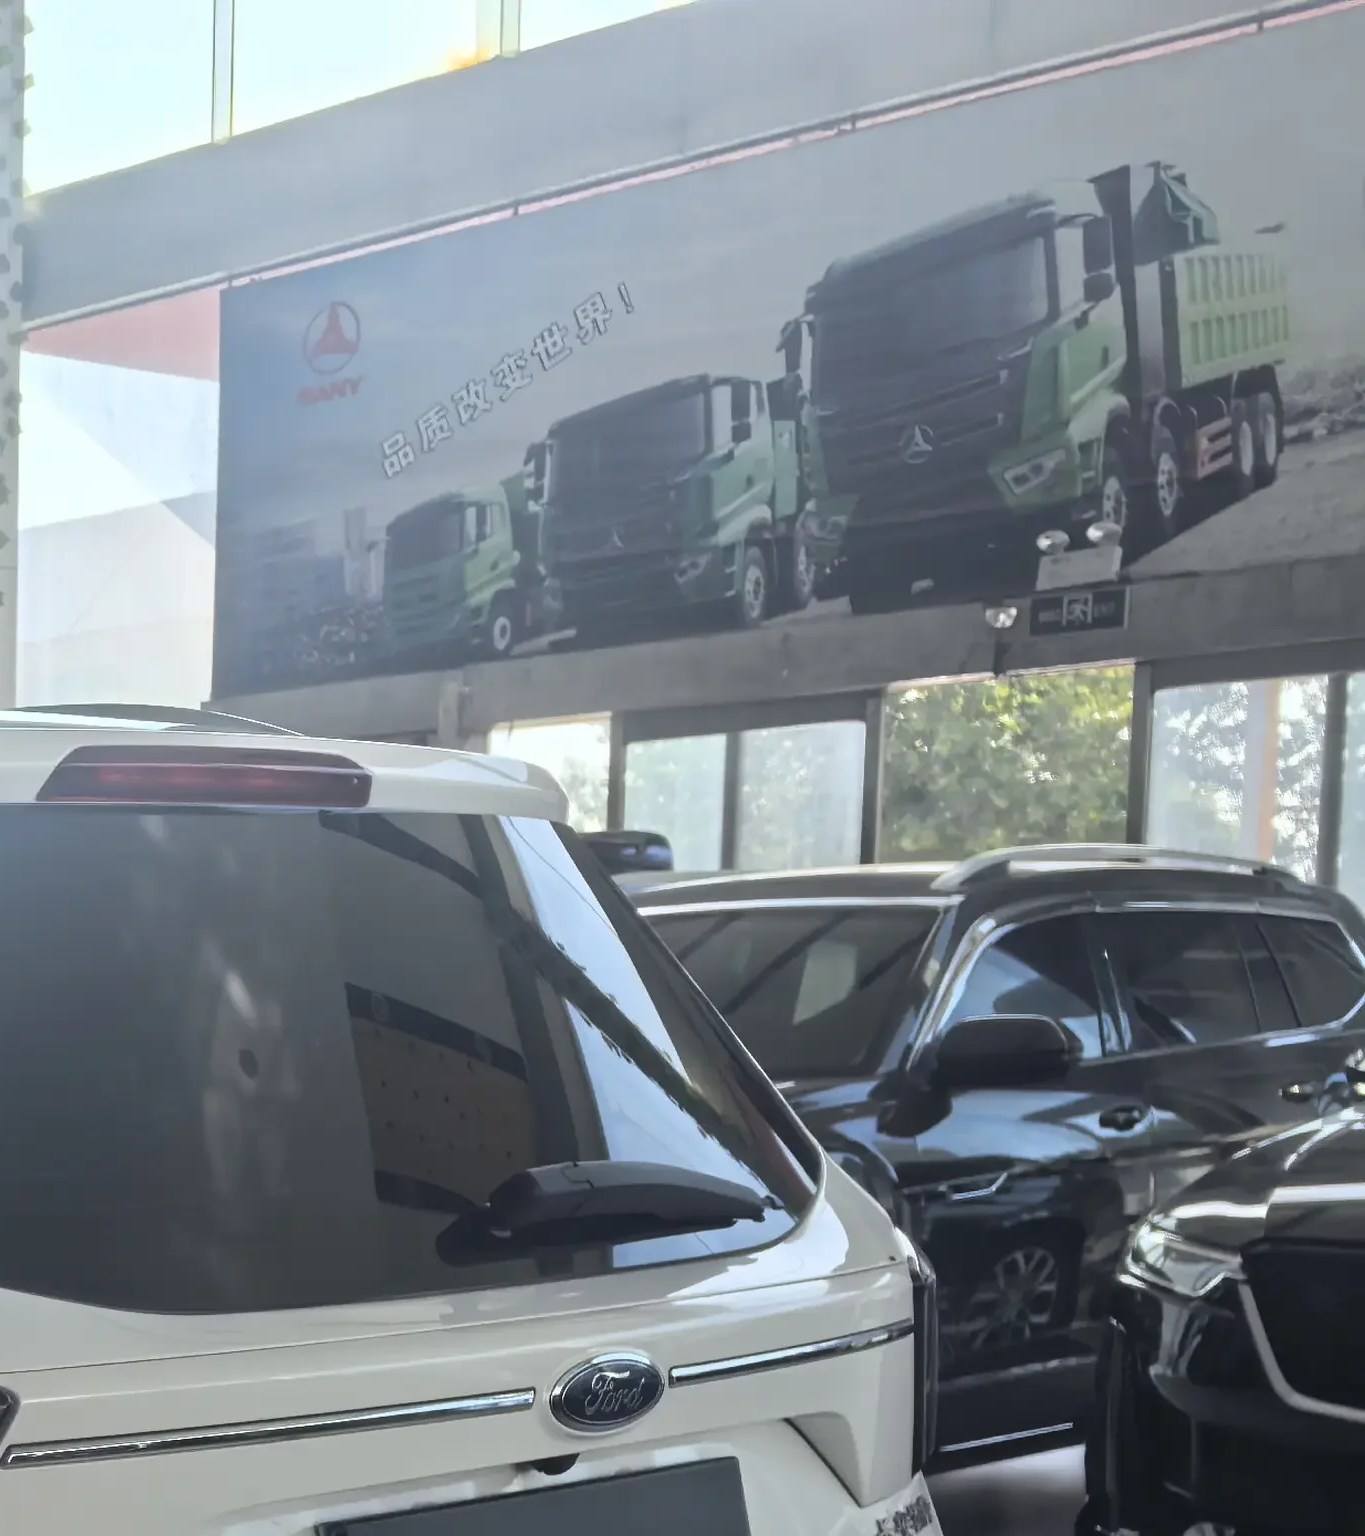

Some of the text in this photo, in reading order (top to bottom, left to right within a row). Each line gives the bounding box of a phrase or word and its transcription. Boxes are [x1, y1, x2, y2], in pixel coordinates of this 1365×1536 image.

[381, 281, 635, 479] 品质改变世界！
[584, 1370, 645, 1416] Ford
